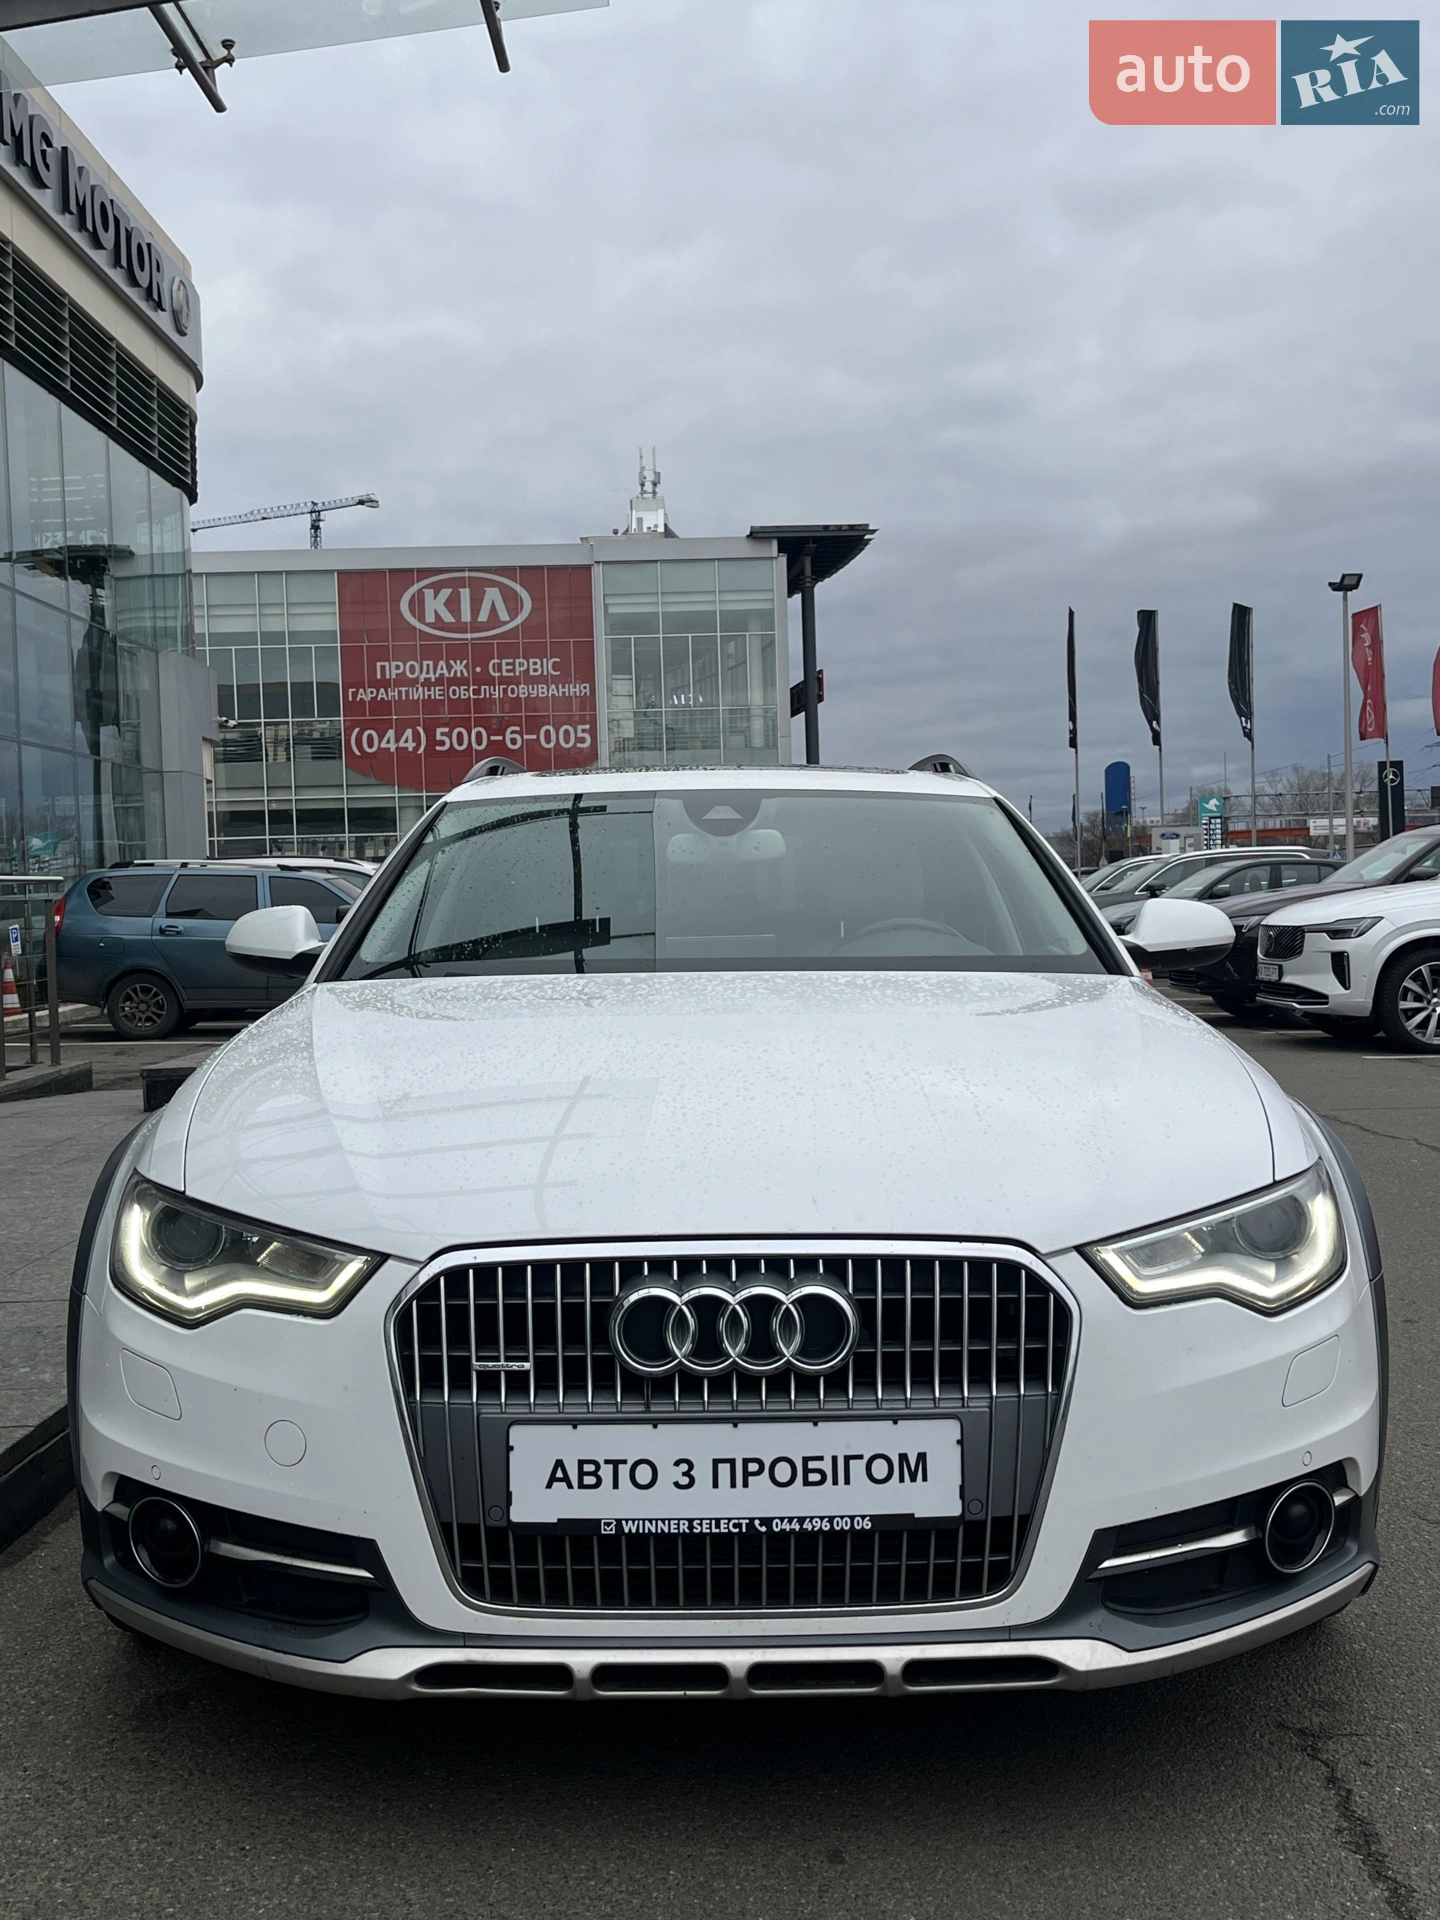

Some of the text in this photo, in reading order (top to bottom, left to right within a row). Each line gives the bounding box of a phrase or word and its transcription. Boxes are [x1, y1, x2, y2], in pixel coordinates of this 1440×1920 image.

[0, 68, 167, 313] MG MOTOR
[422, 586, 511, 624] KIA
[376, 658, 561, 682] ПРОДАЖ СЕРВІС
[348, 683, 591, 702] ГАРАНТІЙНЕ ОБСЛУГОВУВАННЯ
[350, 724, 592, 756] (044) 500-6-005
[545, 1458, 659, 1490] АВТО
[711, 1452, 928, 1489] ПРОБІГОМ
[621, 1516, 872, 1533] WINNER SELECT 044 496 00 06
